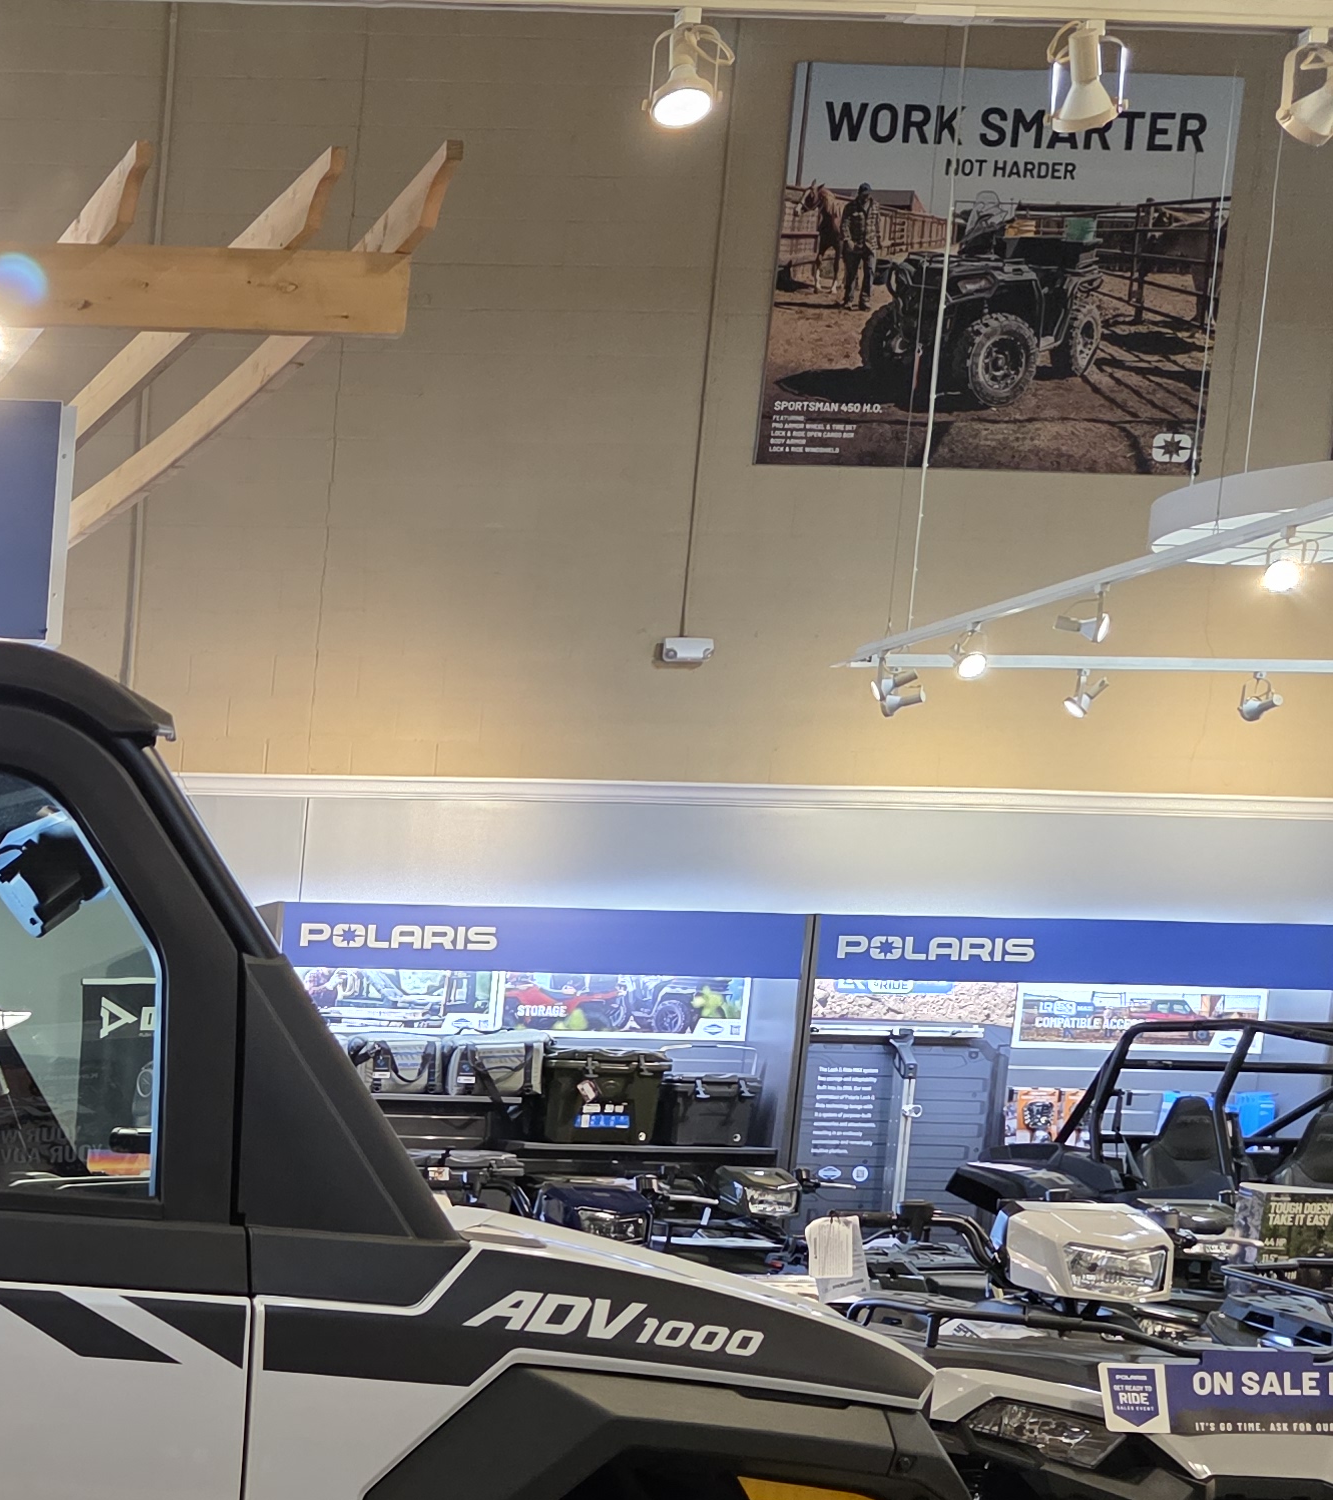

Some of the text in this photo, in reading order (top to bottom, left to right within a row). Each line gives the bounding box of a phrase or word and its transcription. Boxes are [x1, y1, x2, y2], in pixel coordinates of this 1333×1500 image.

[825, 101, 965, 145] WORK
[944, 158, 1077, 181] NOT HARDER
[774, 401, 883, 413] SPORTSMAN 450 H.O.
[299, 922, 498, 951] POLARIS
[836, 935, 1036, 963] POLARIS
[517, 1004, 568, 1018] STORAGE
[1034, 1017, 1102, 1030] COMPATIBLE
[1270, 1202, 1303, 1214] TOUGH
[1268, 1214, 1331, 1226] TAKE IT EASY
[462, 1290, 765, 1357] ADV 1000
[1193, 1371, 1233, 1396] ON
[1241, 1371, 1321, 1396] SALE
[1118, 1392, 1150, 1405] RIDE
[1195, 1422, 1216, 1431] IT'S
[1219, 1422, 1233, 1431] GO
[1237, 1422, 1266, 1431] TIME.
[1270, 1422, 1289, 1431] ASK
[1293, 1422, 1312, 1432] FOR
